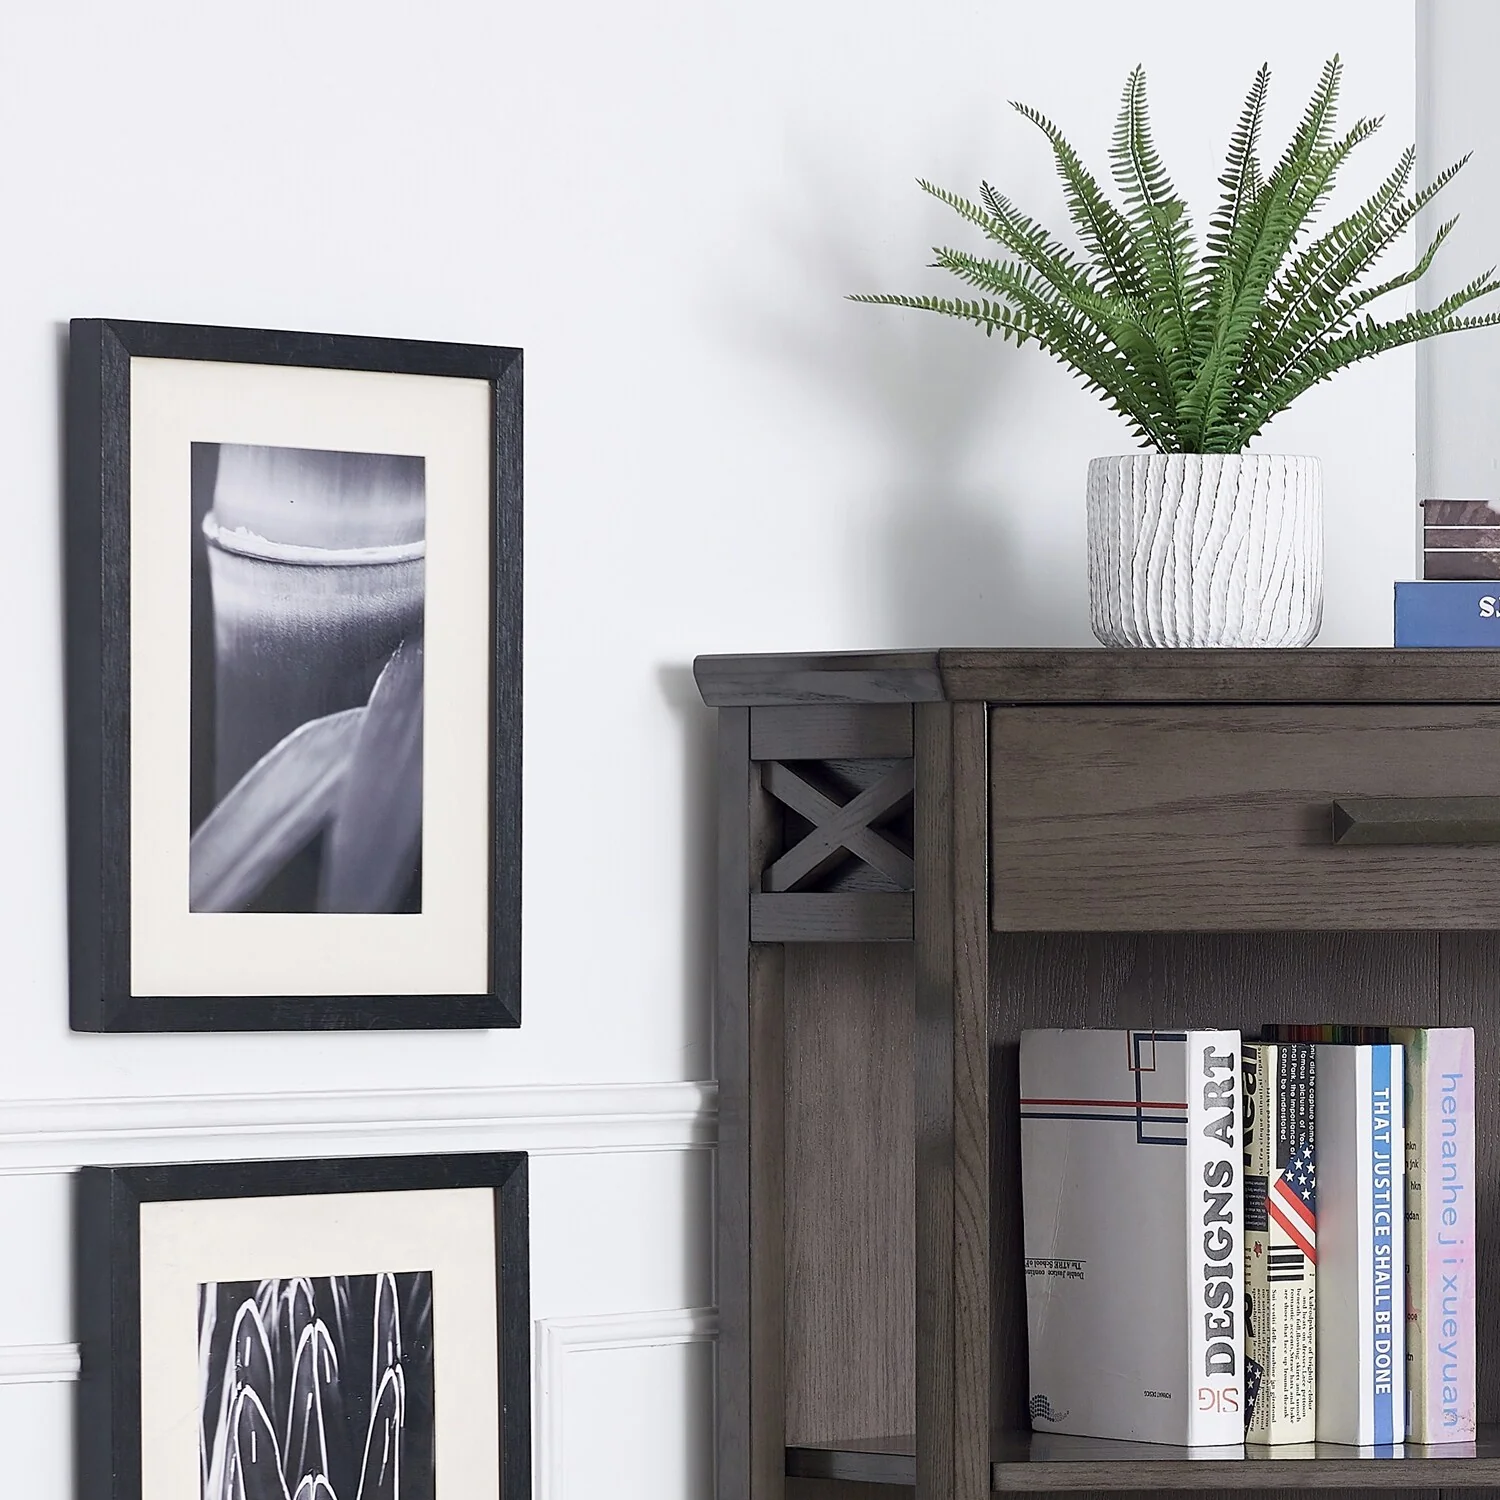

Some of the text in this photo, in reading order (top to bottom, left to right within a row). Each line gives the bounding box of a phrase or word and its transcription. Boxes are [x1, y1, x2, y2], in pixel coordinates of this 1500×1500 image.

[1203, 1046, 1236, 1378] DESIGNS ART
[1441, 1073, 1464, 1227] henanhe
[1373, 1087, 1391, 1395] THAT JUSTICE SHALL BE DONE
[1198, 1388, 1239, 1413] SIG
[1437, 1273, 1460, 1428] xueyuan
